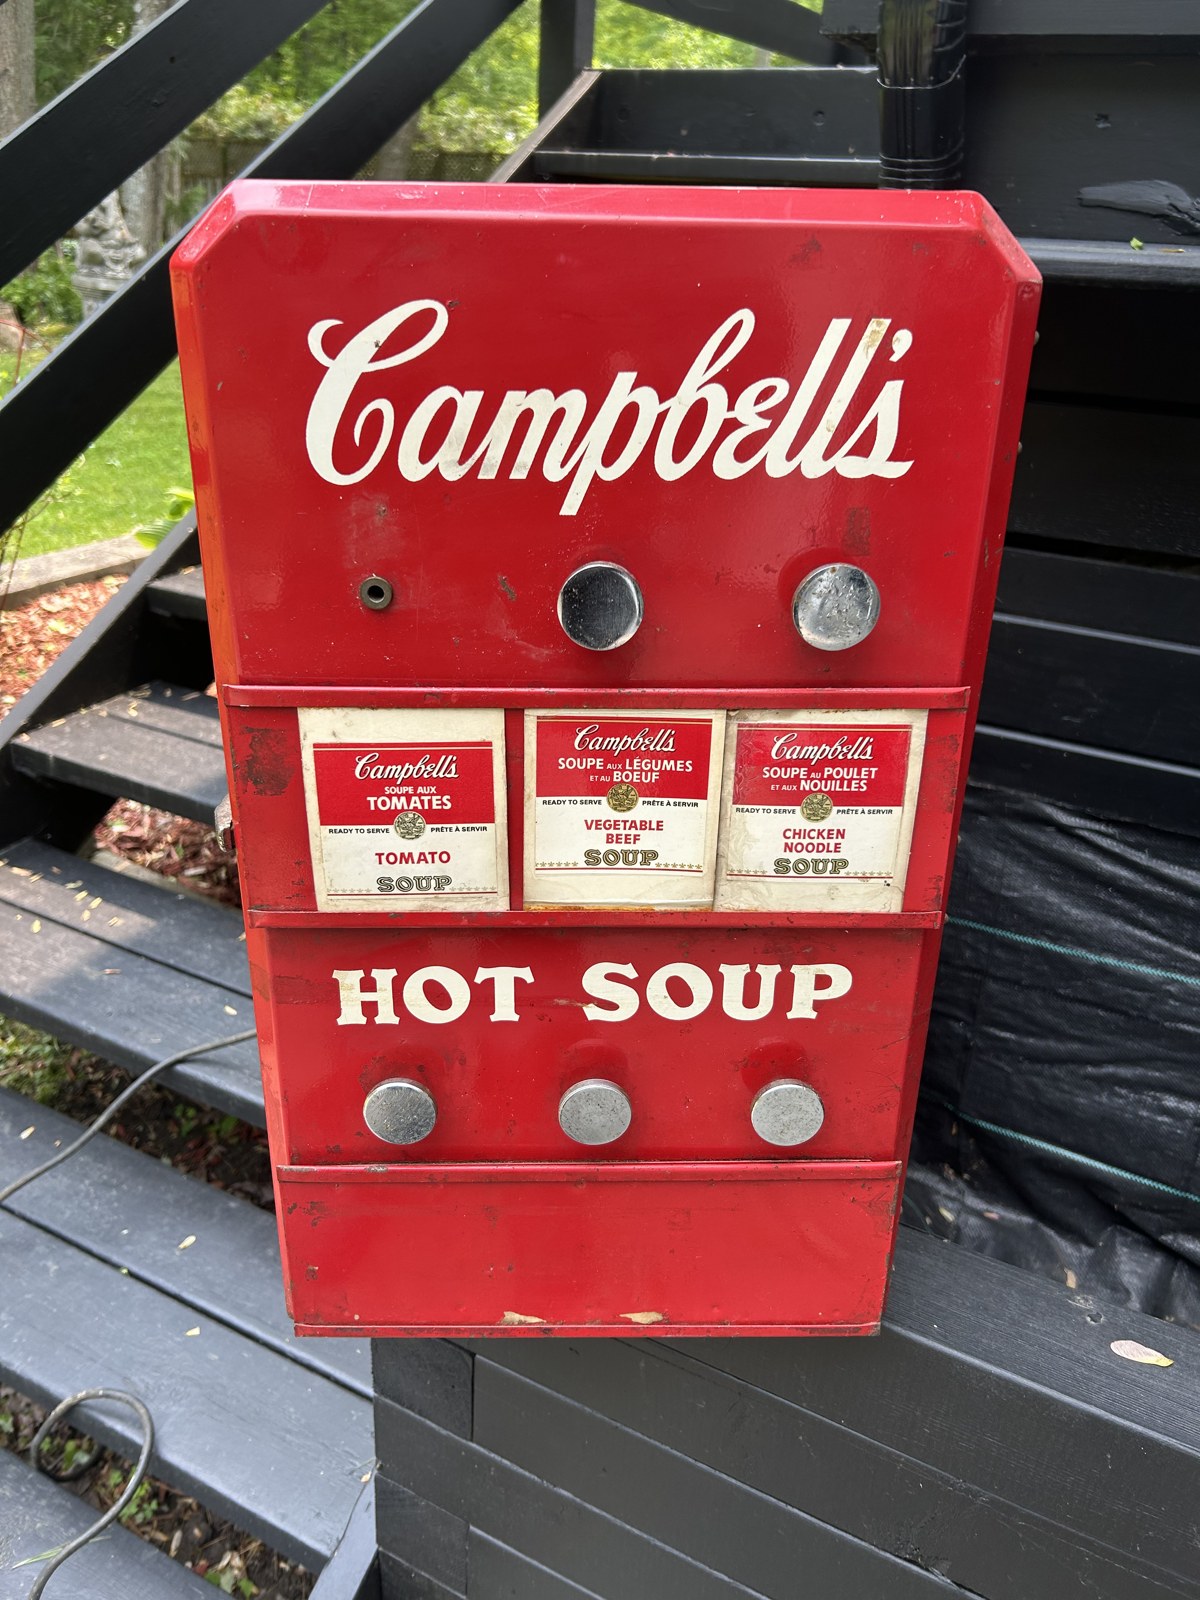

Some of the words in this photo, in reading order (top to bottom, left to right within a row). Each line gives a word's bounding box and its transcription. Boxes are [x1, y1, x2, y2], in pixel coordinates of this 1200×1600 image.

[305, 298, 915, 516] Campbell's
[574, 725, 676, 756] Campbell's
[771, 733, 873, 765] Campbell's
[355, 753, 459, 784] Campbell's
[558, 758, 604, 770] SOUPE
[625, 756, 693, 772] LÉGUMES
[613, 771, 659, 783] BOEUF
[762, 767, 808, 779] SOUPE
[824, 768, 878, 779] POULET
[385, 786, 414, 794] SOUPE
[417, 786, 436, 794] AUX
[800, 780, 867, 791] NOUILLES
[367, 796, 452, 810] TOMATES
[584, 819, 664, 831] VEGETABLE
[605, 833, 641, 844] BEEF
[783, 829, 846, 840] CHICKEN
[783, 842, 842, 853] NOODLE
[375, 851, 451, 865] TOMATO
[584, 849, 659, 866] SOUP
[774, 858, 849, 874] SOUP
[376, 875, 452, 892] SOUP
[331, 965, 535, 1026] HOT
[581, 961, 853, 1021] SOUP
